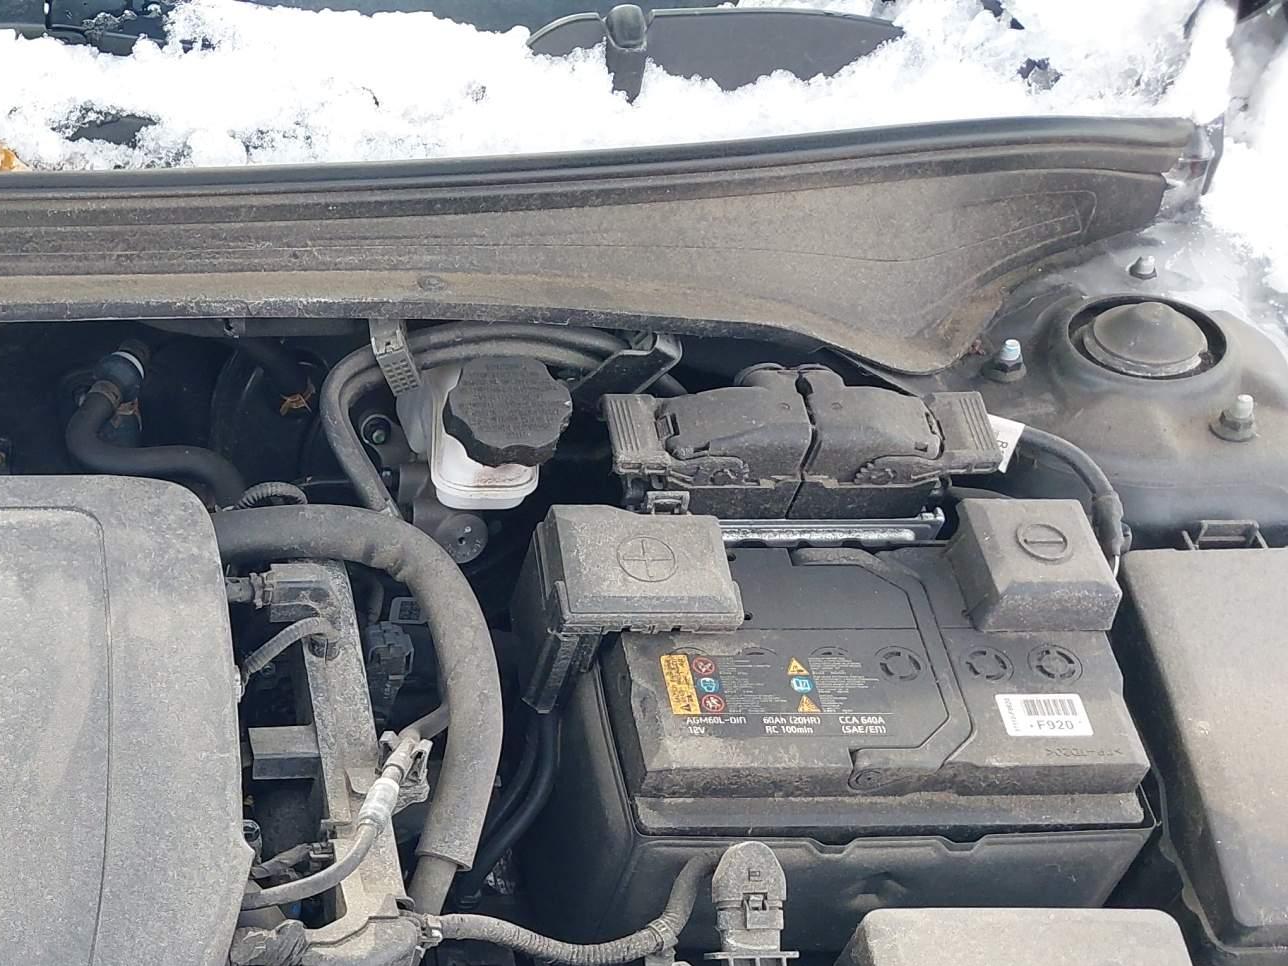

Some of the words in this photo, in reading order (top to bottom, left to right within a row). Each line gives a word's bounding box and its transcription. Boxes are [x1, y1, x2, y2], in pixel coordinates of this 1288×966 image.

[763, 716, 786, 725] 60Ah
[790, 716, 821, 725] (20HR)
[839, 716, 859, 725] CCA
[861, 716, 885, 725] 640A
[688, 726, 705, 734] 12V
[765, 725, 779, 734] RC
[781, 725, 813, 734] 100min
